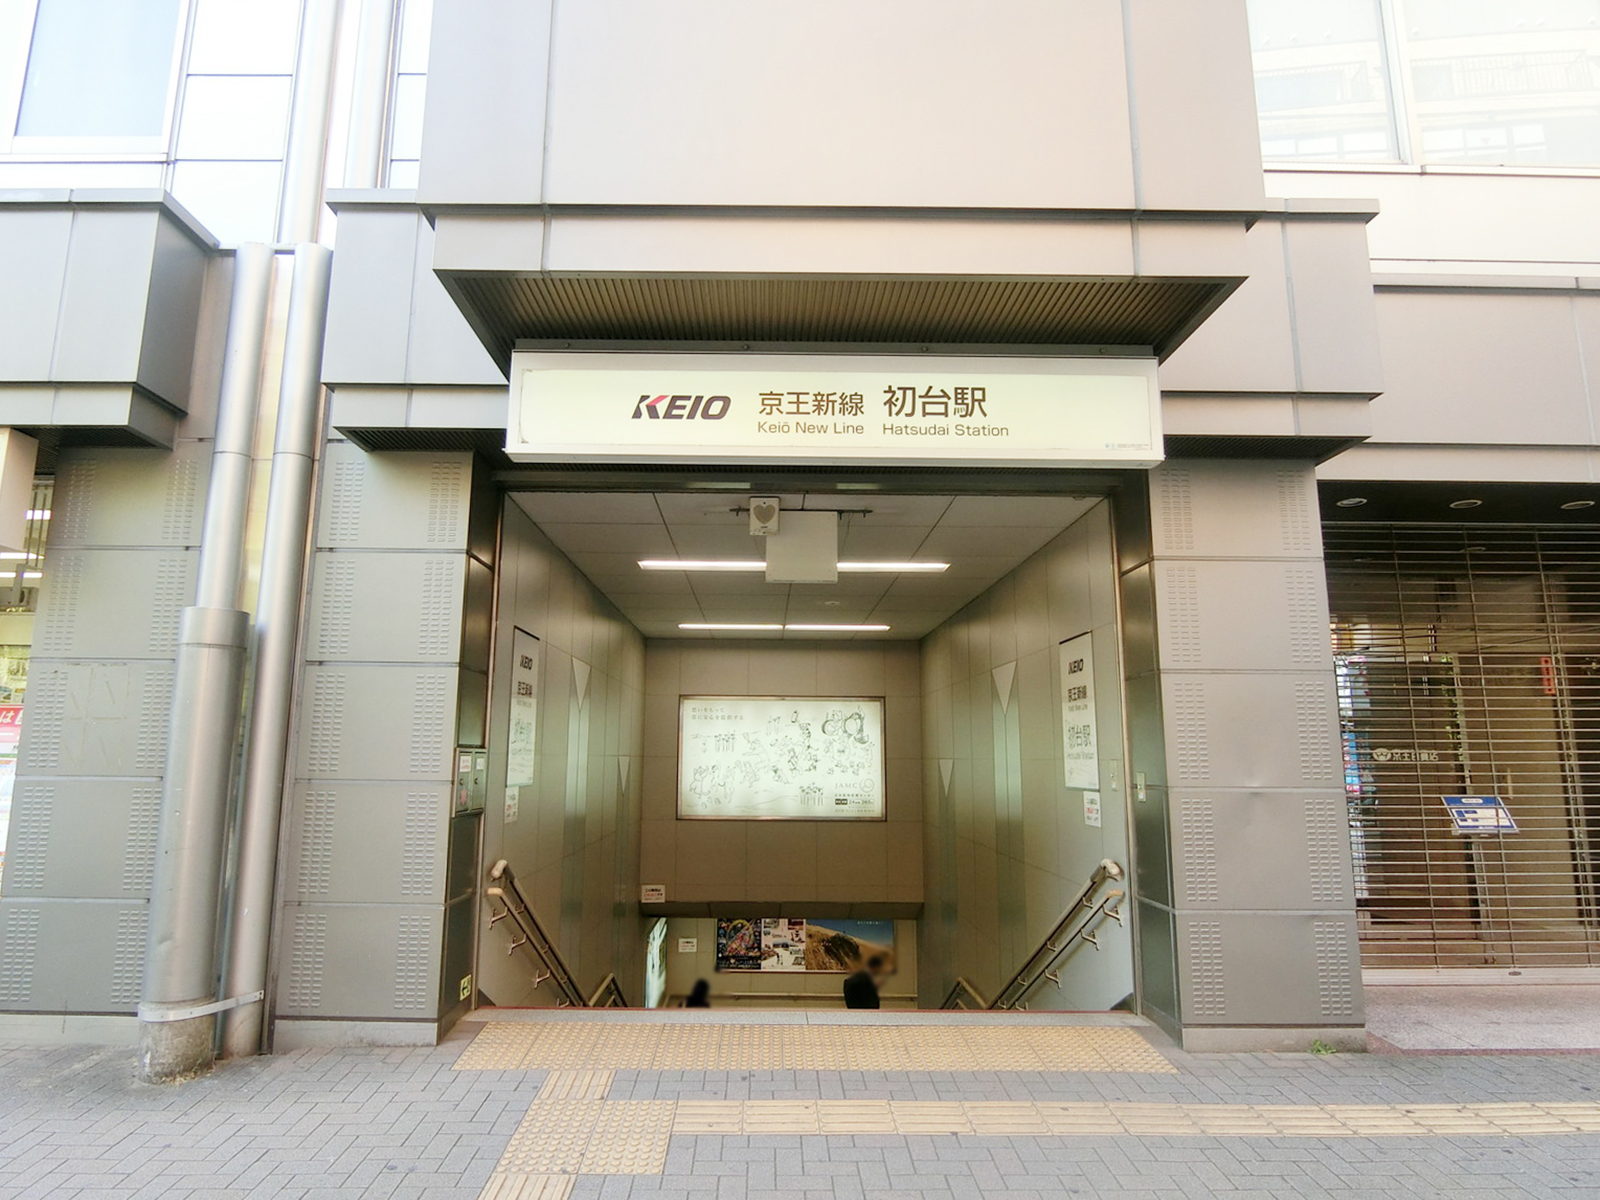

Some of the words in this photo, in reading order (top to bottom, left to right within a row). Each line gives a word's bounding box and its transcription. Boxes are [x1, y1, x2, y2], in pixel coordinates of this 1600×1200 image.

[631, 395, 731, 420] KEIO
[758, 391, 865, 417] 京王新線
[883, 385, 987, 418] 初台駅
[795, 422, 828, 434] New
[833, 422, 864, 434] Line
[883, 423, 949, 436] Hatsudai
[954, 424, 1009, 437] Station
[1068, 658, 1084, 675] KEIO
